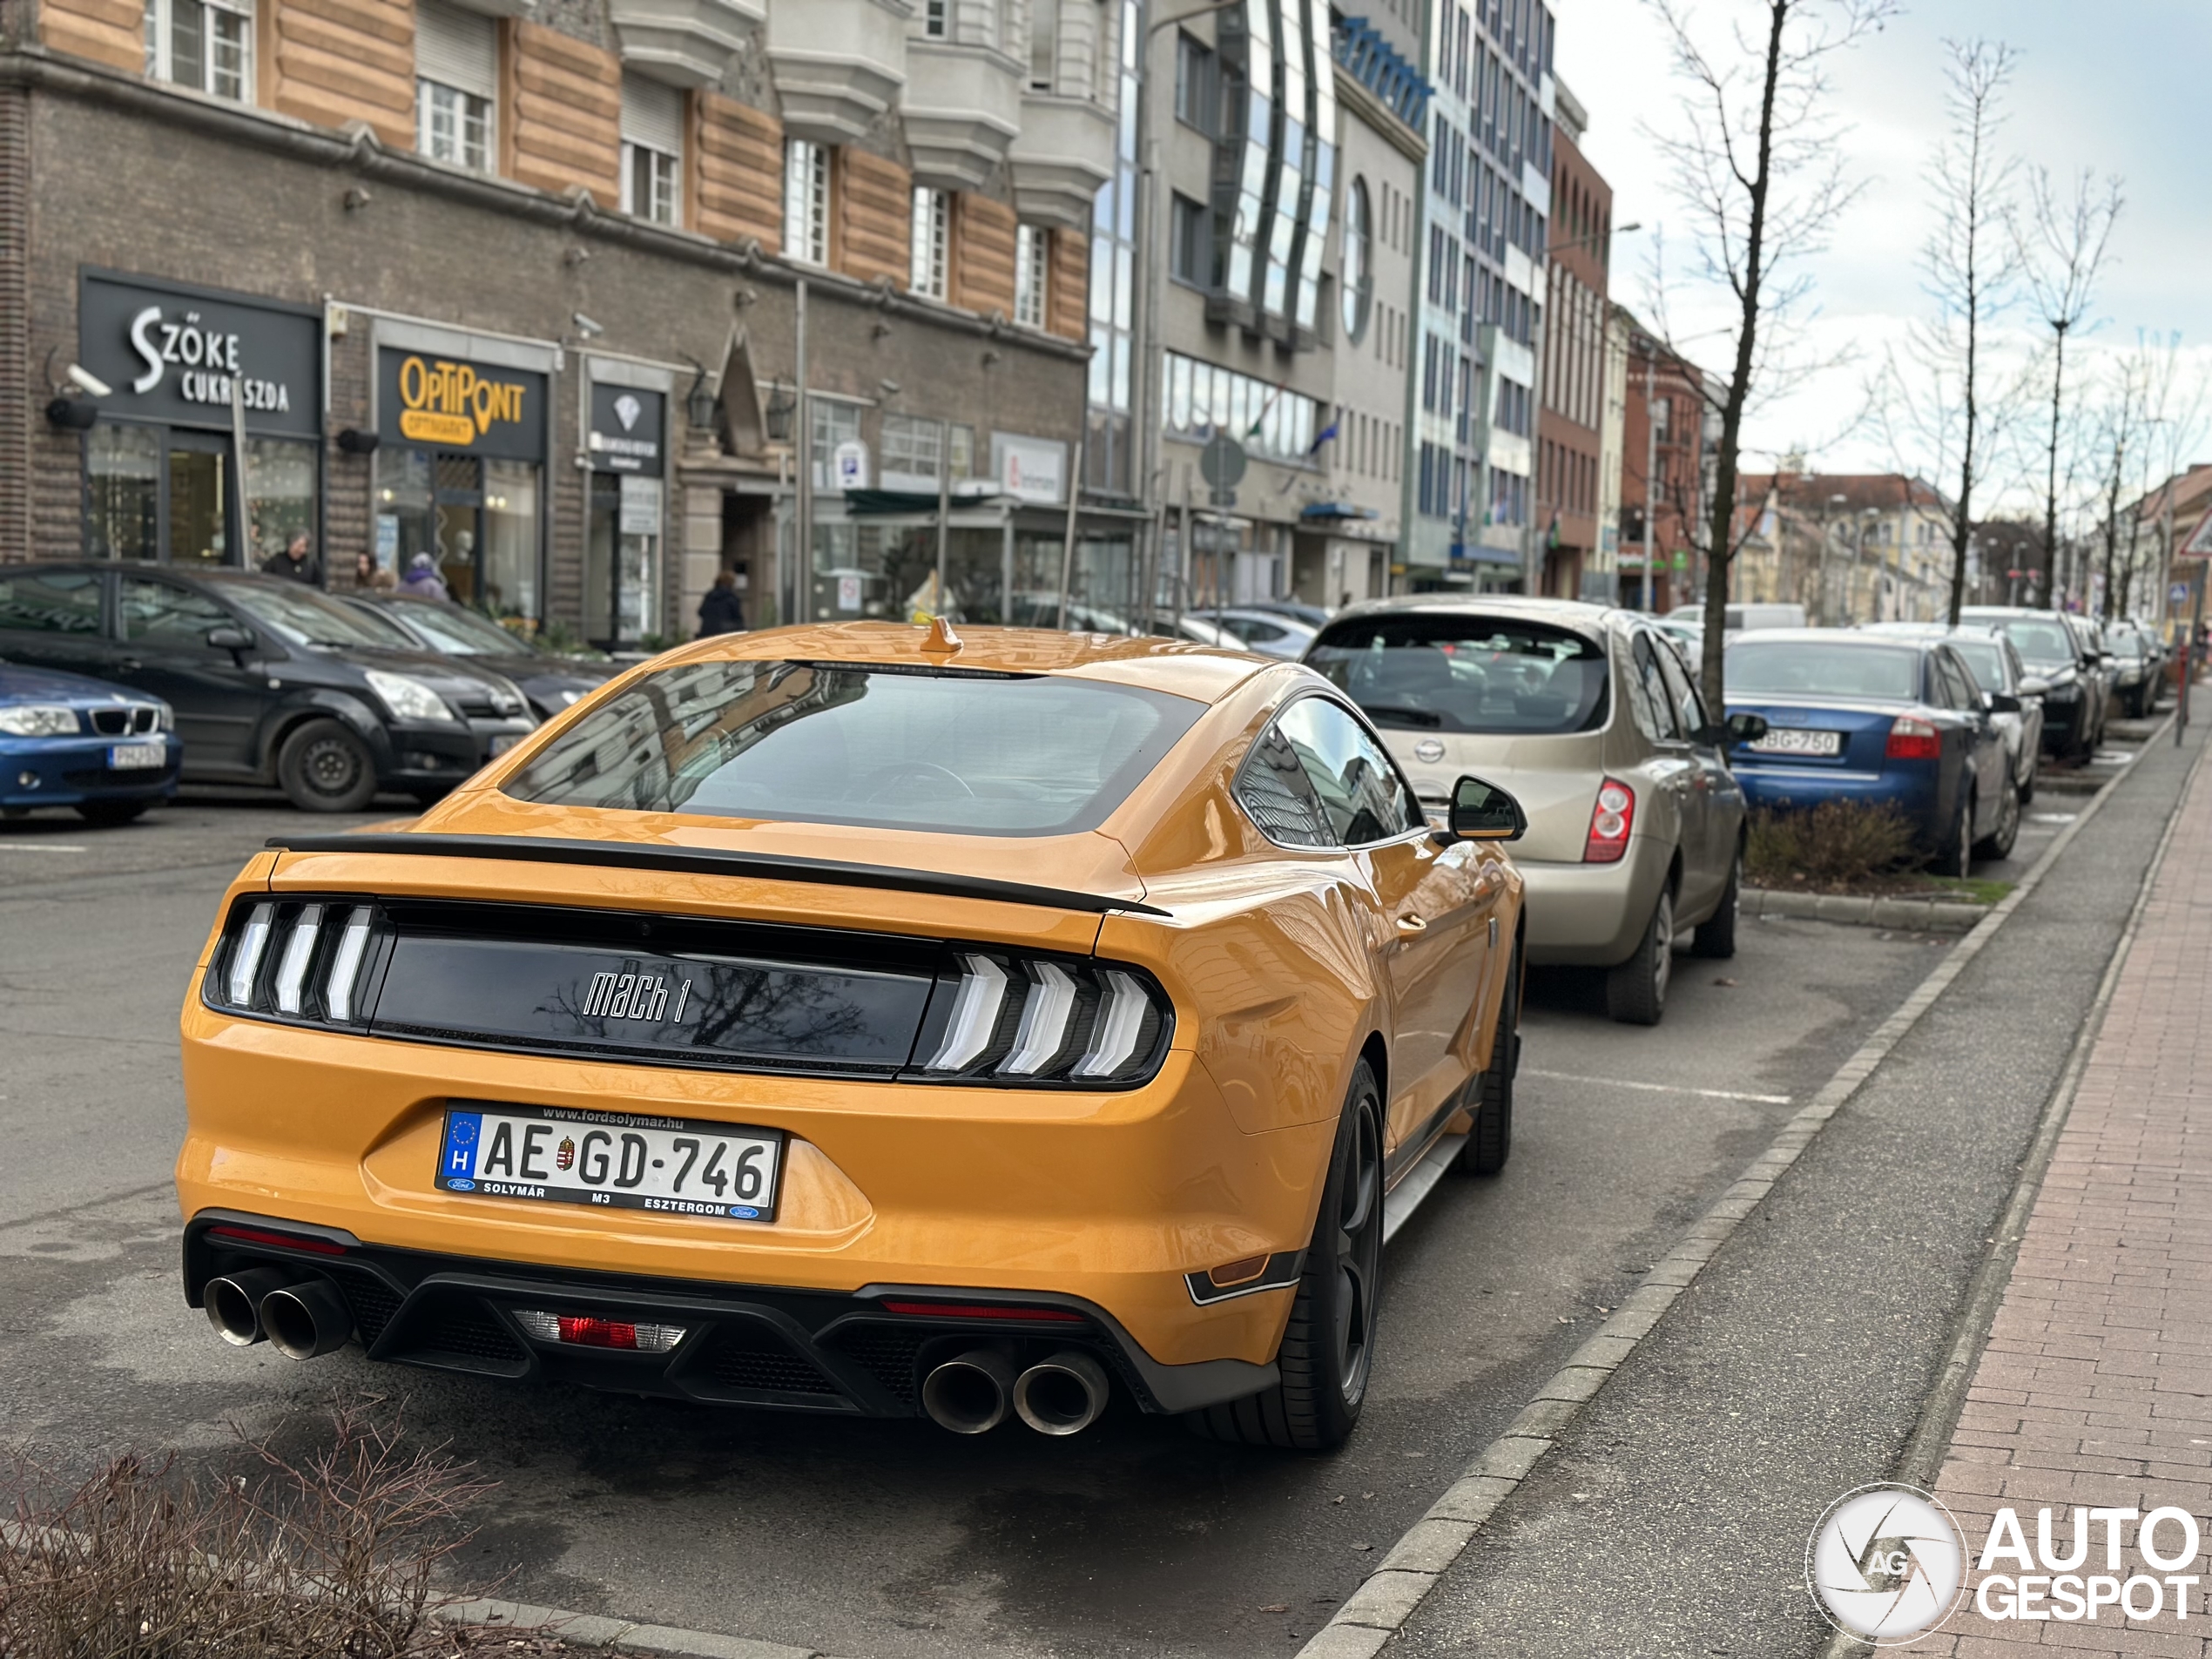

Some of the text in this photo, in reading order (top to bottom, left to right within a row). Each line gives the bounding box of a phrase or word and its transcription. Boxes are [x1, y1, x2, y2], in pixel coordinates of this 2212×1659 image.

[543, 1107, 685, 1130] www.fordsolymar.hu
[451, 1150, 469, 1170] H
[484, 1121, 764, 1200] AE GD-746
[450, 1179, 473, 1190] Ford
[483, 1182, 545, 1197] SOLYMÁR
[592, 1192, 610, 1204] M3
[644, 1198, 725, 1216] ESZTERGOM
[733, 1207, 754, 1217] Ford
